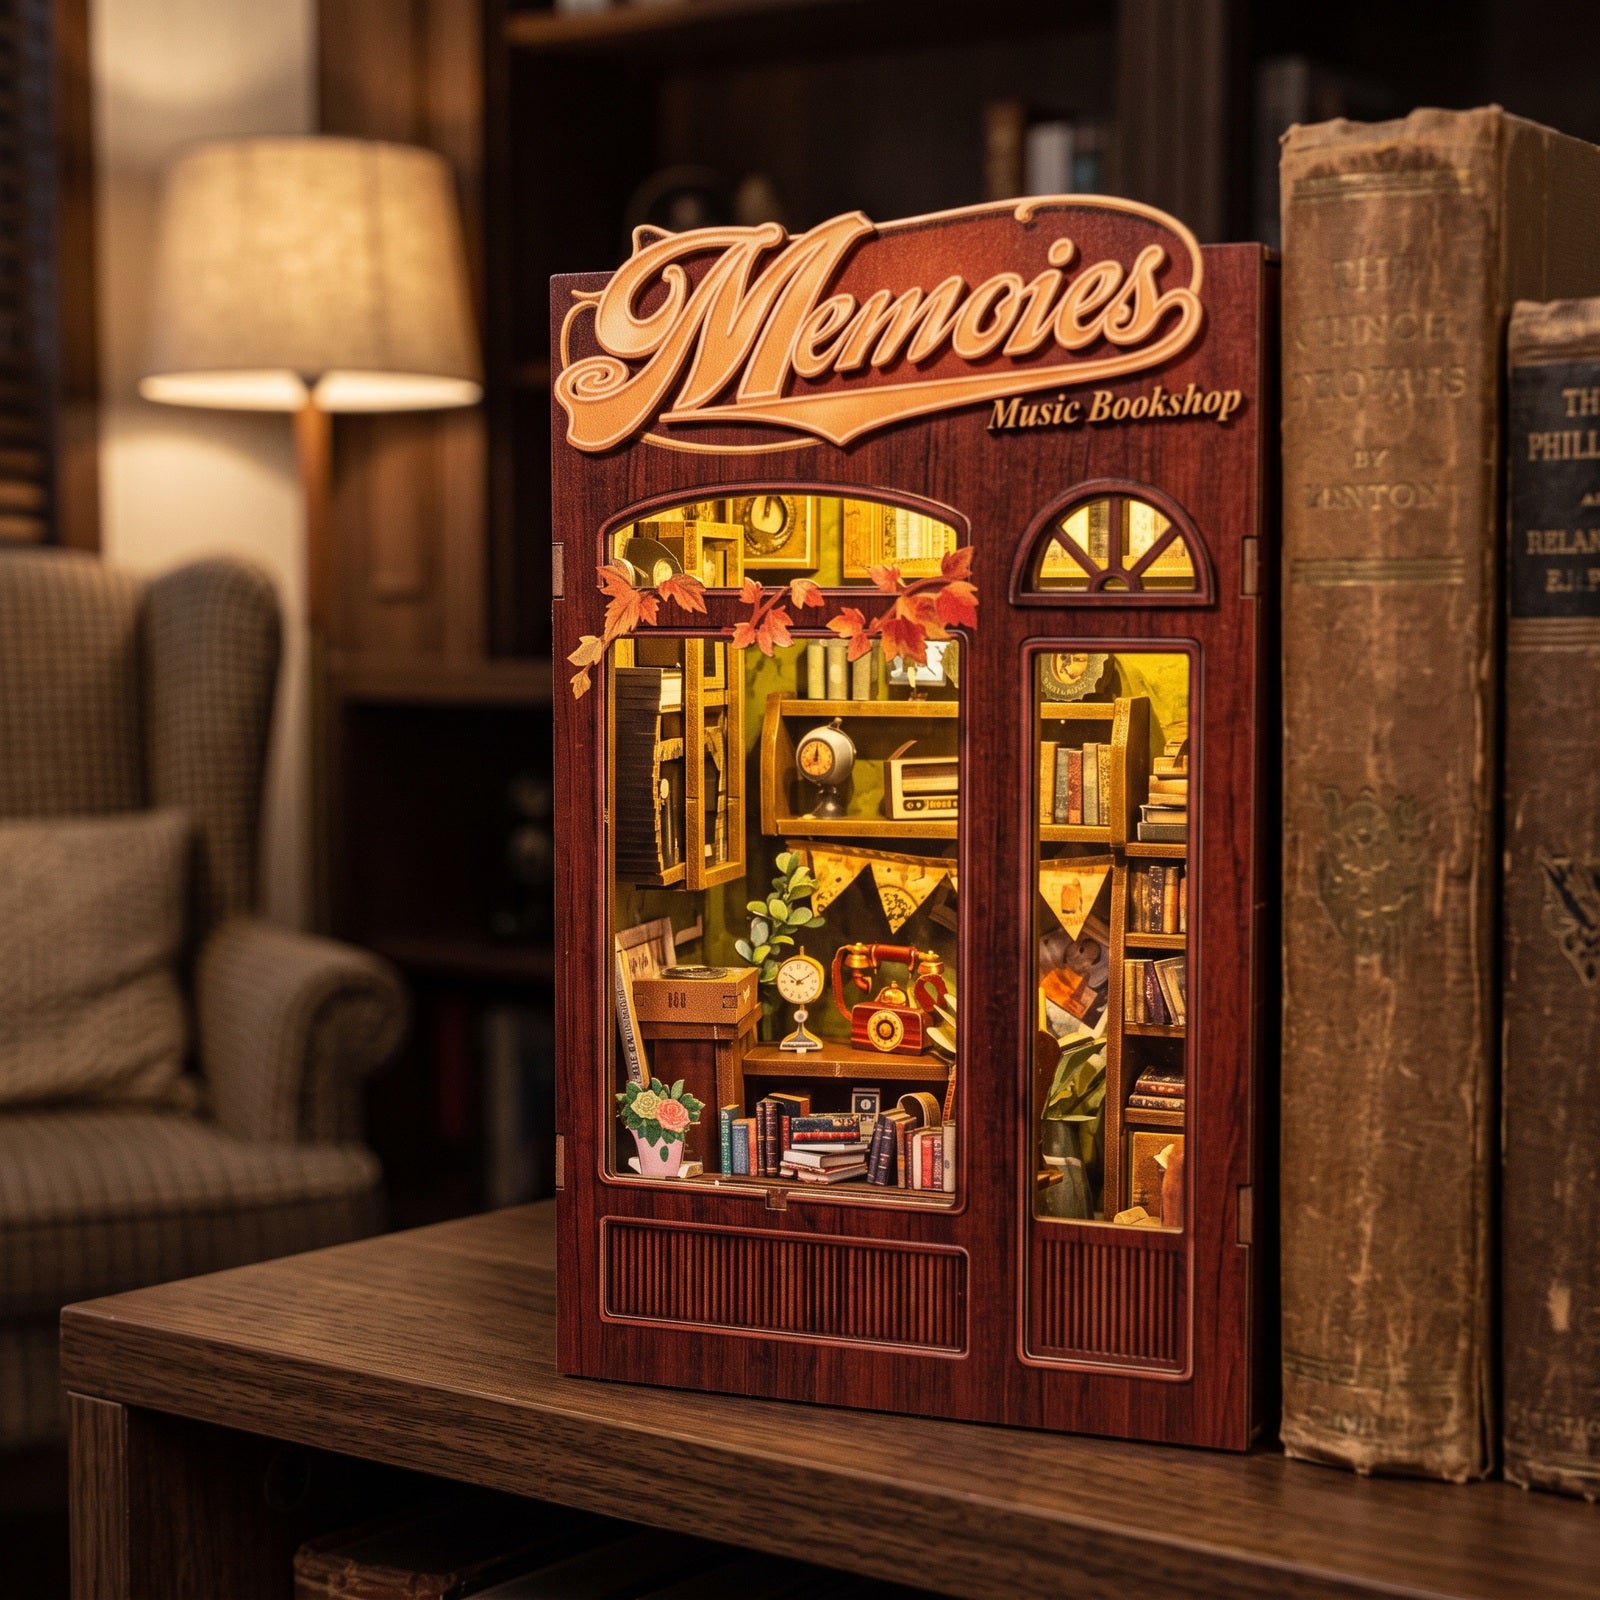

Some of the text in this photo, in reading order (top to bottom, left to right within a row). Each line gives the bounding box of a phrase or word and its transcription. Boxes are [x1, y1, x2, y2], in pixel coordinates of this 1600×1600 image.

[553, 208, 1203, 452] Memoies
[987, 382, 1242, 430] Music Bookshop
[1352, 448, 1390, 469] BY
